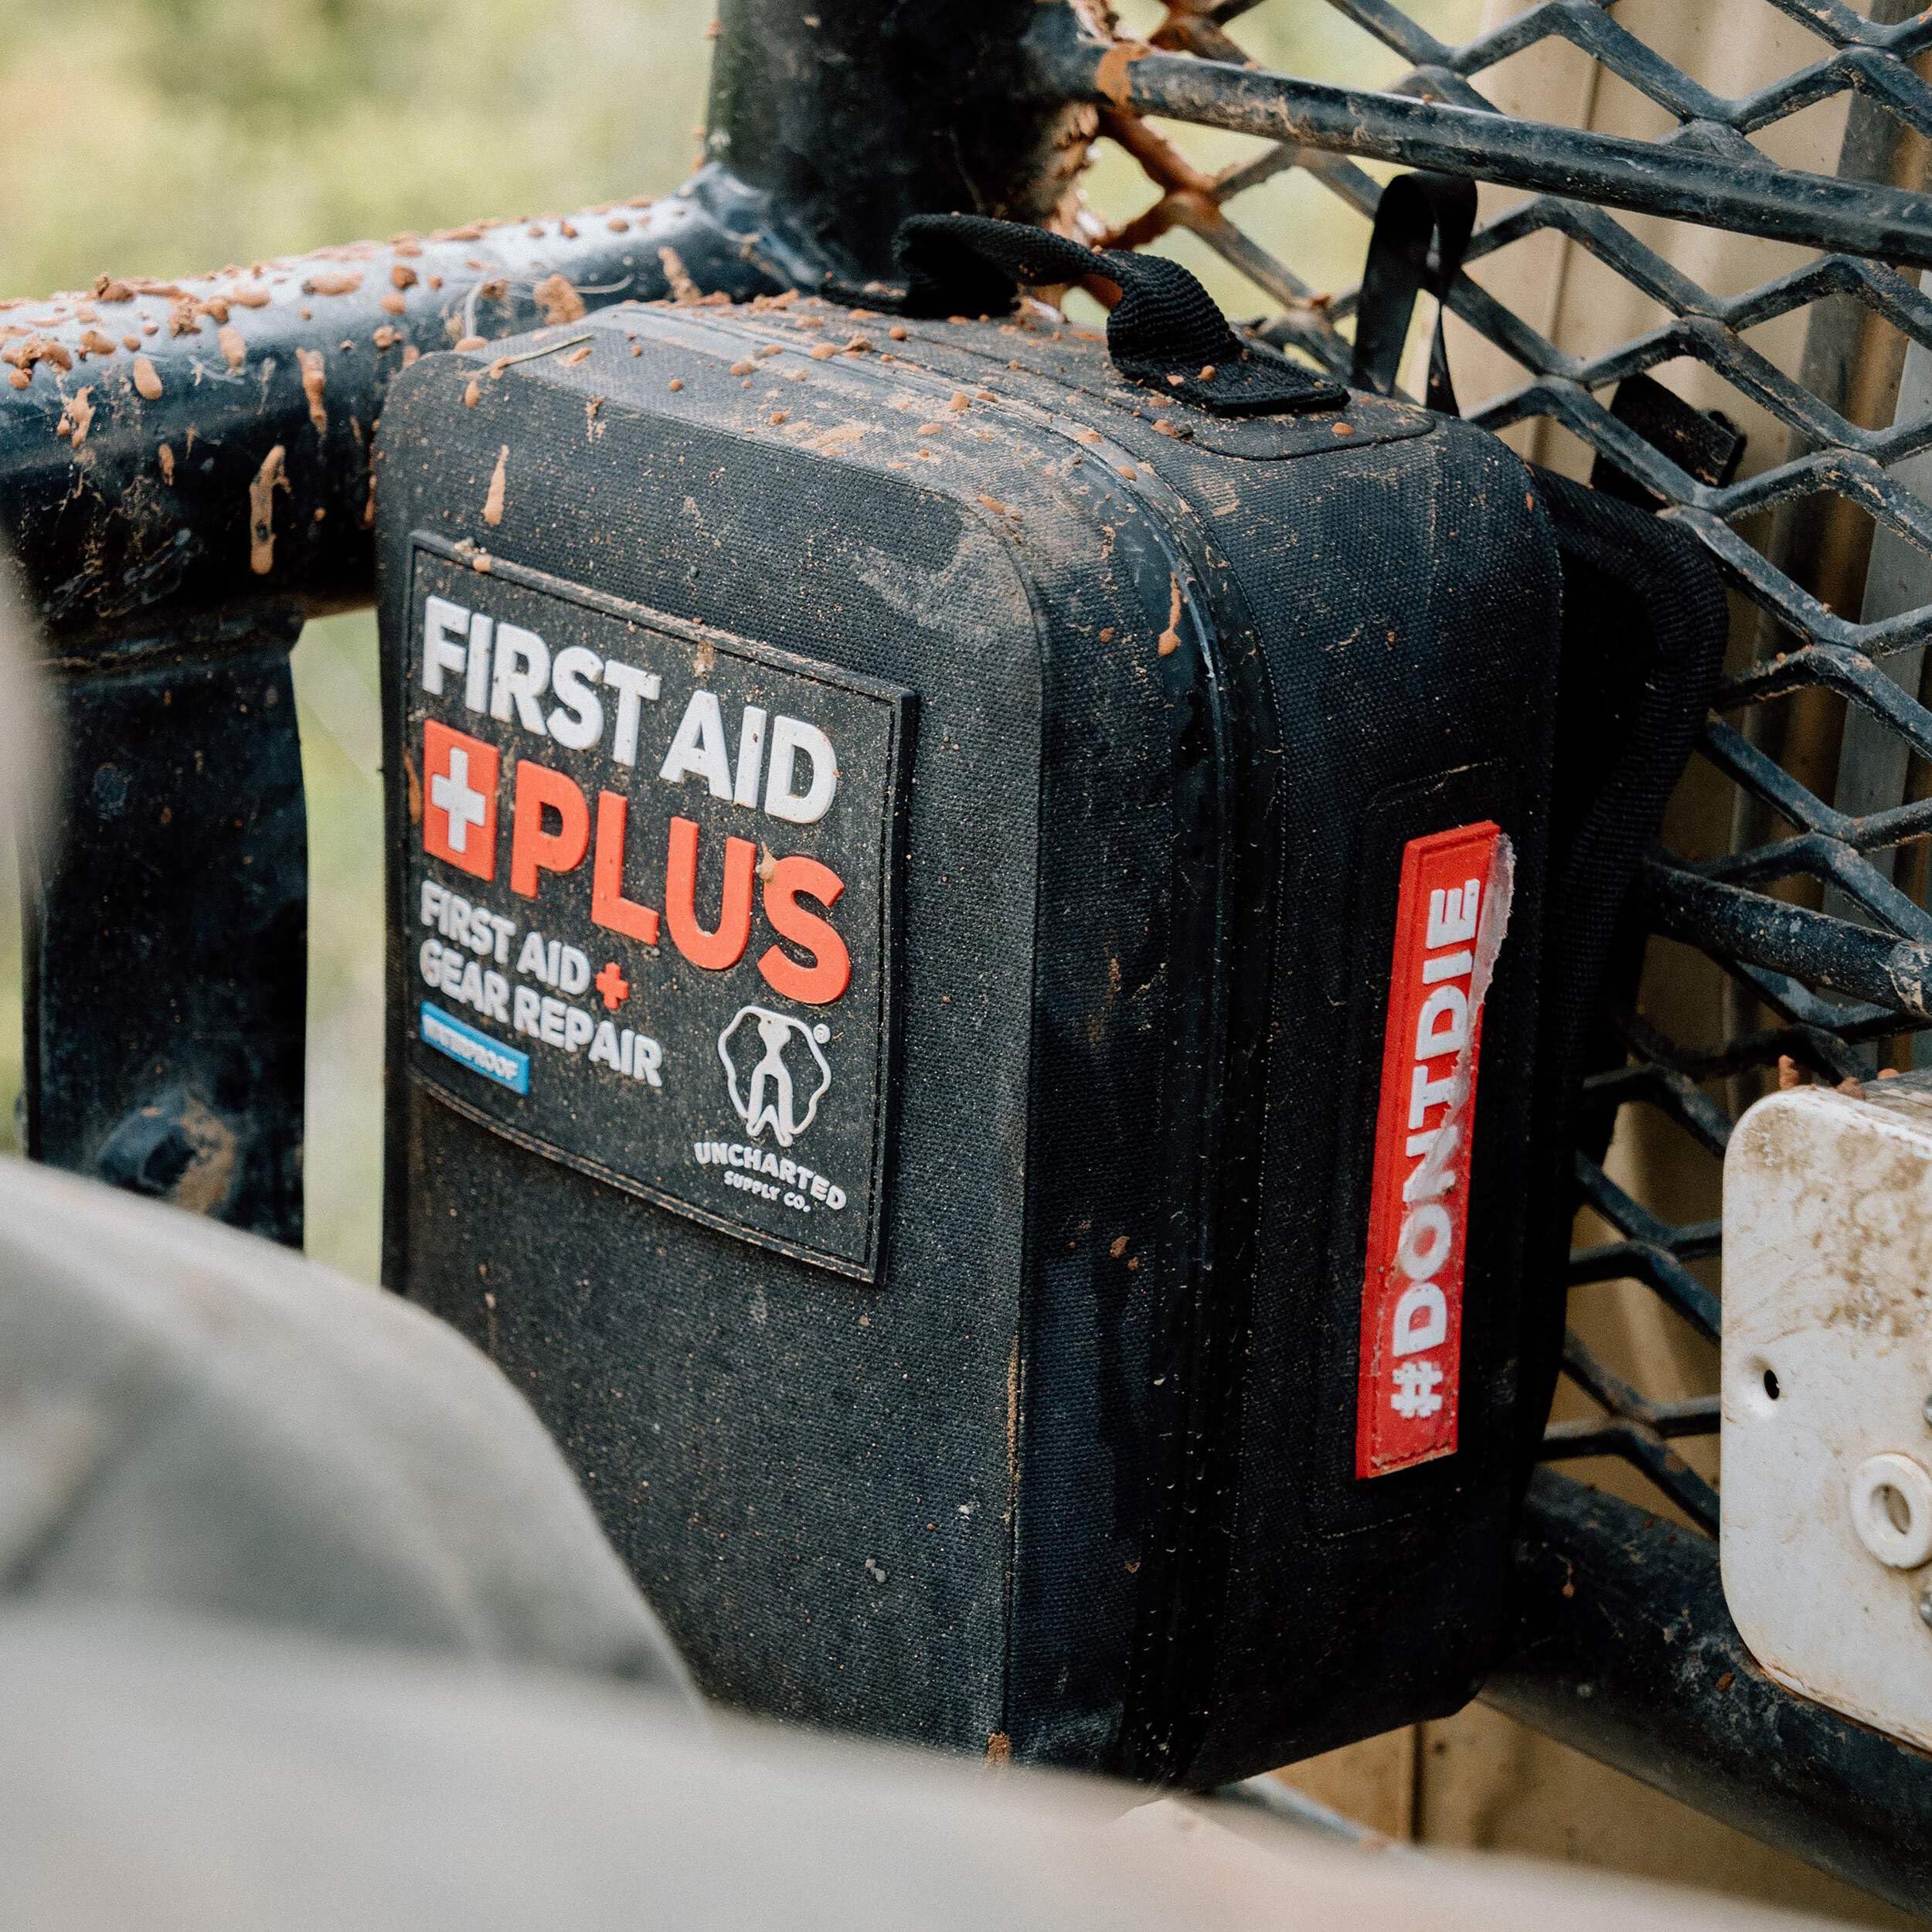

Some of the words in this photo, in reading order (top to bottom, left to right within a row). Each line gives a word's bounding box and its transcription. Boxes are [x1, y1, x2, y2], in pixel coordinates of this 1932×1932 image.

[422, 595, 661, 766] FIRST
[659, 689, 838, 825] AID
[420, 879, 516, 964] FIRST
[516, 931, 591, 995] AID
[510, 760, 851, 1005] PLUS
[420, 938, 510, 1023] GEAR
[513, 985, 663, 1087] REPAIR
[693, 1141, 847, 1210] UNCHARTED
[723, 1170, 781, 1201] SUPPLY
[784, 1192, 811, 1213] CO.
[1390, 878, 1481, 1418] #DONTDIE
